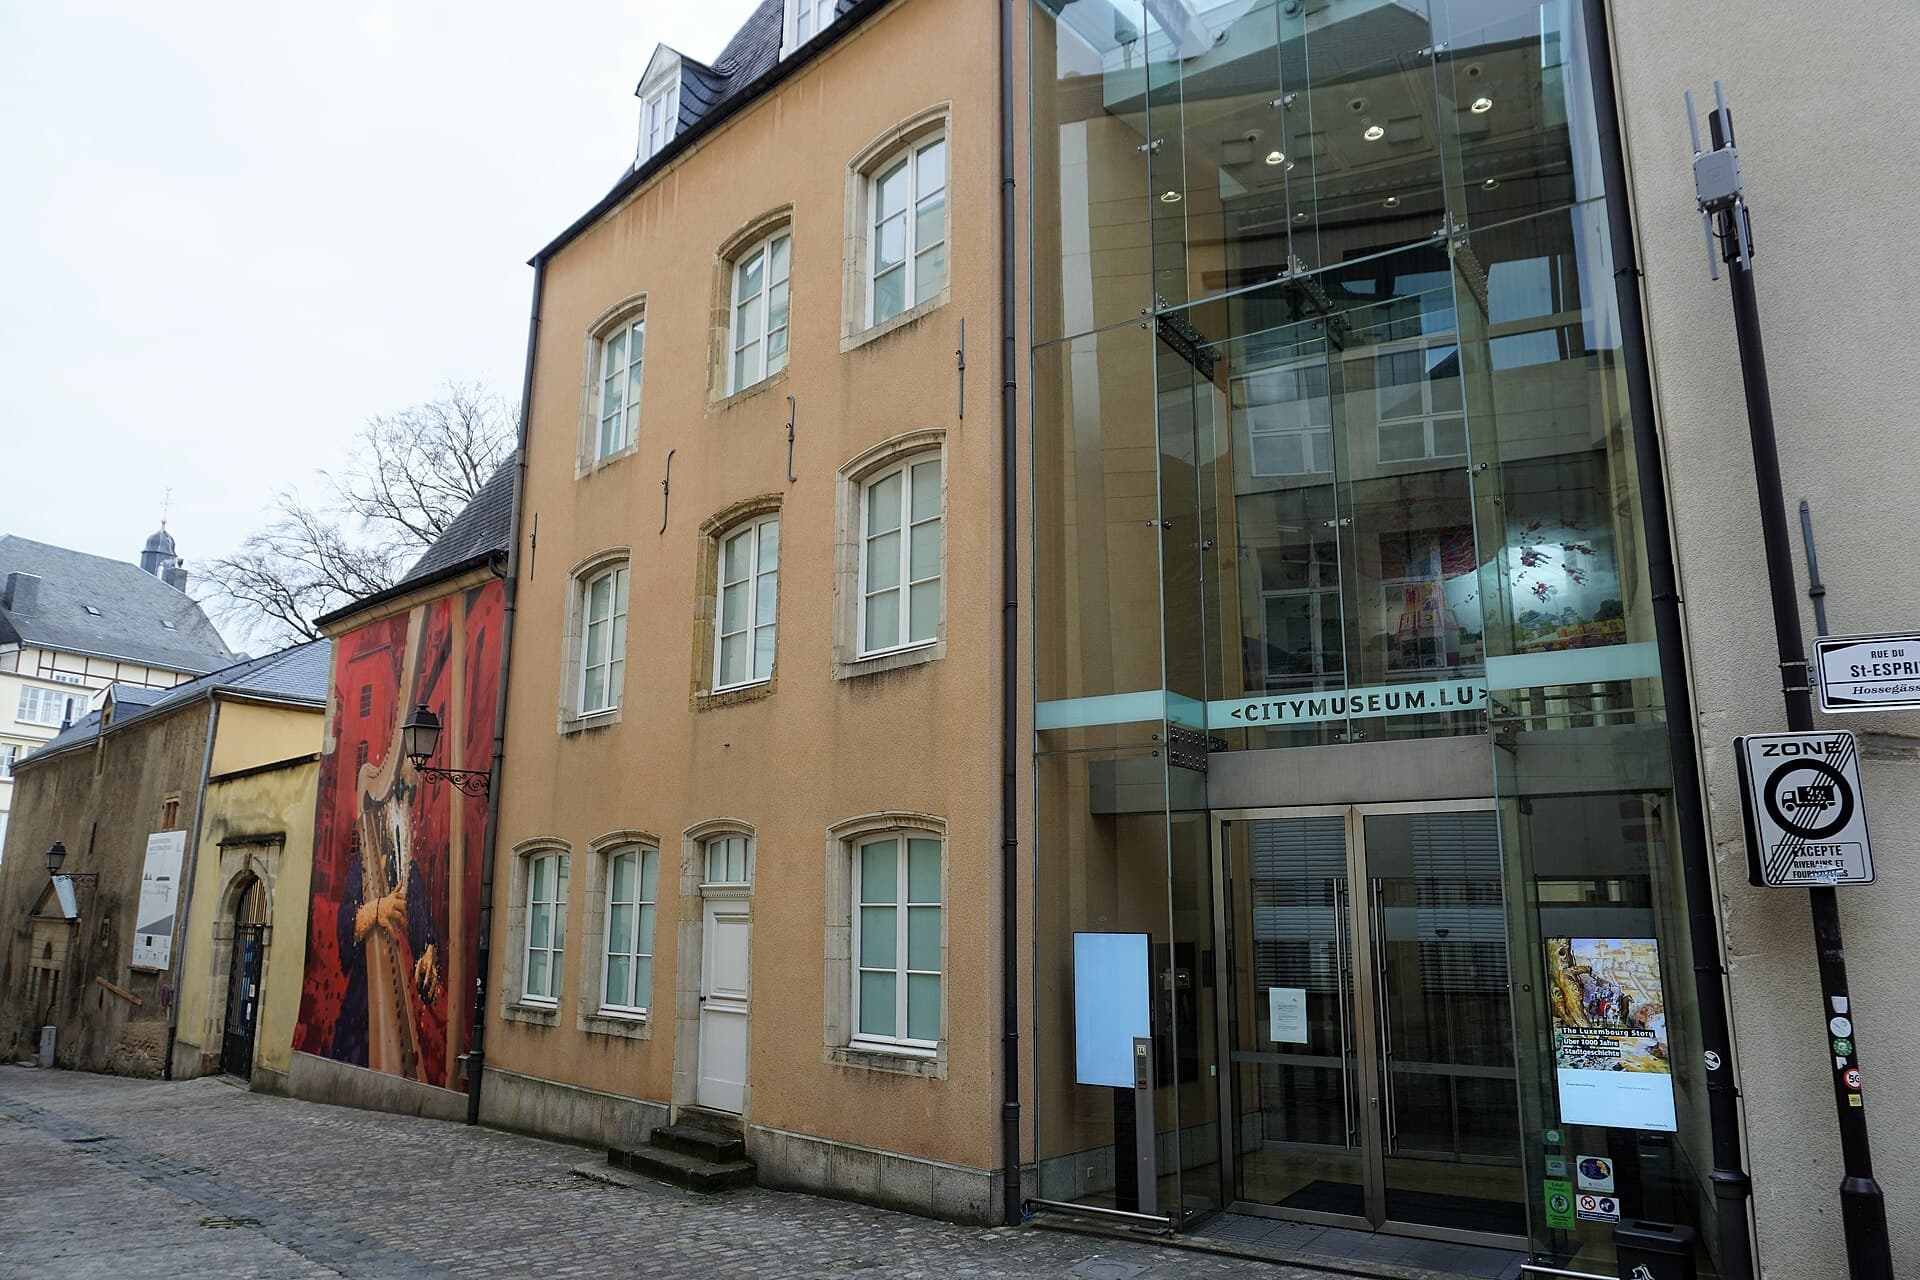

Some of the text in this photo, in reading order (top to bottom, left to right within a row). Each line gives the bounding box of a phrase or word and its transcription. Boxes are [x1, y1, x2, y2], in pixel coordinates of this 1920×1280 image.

[1871, 649, 1904, 658] RUE DU
[1850, 661, 1920, 677] St-ESPRI
[1761, 741, 1841, 757] ZONE
[1835, 860, 1844, 868] ET
[1580, 1028, 1628, 1037] Luxembourg
[1631, 1029, 1654, 1038] Story
